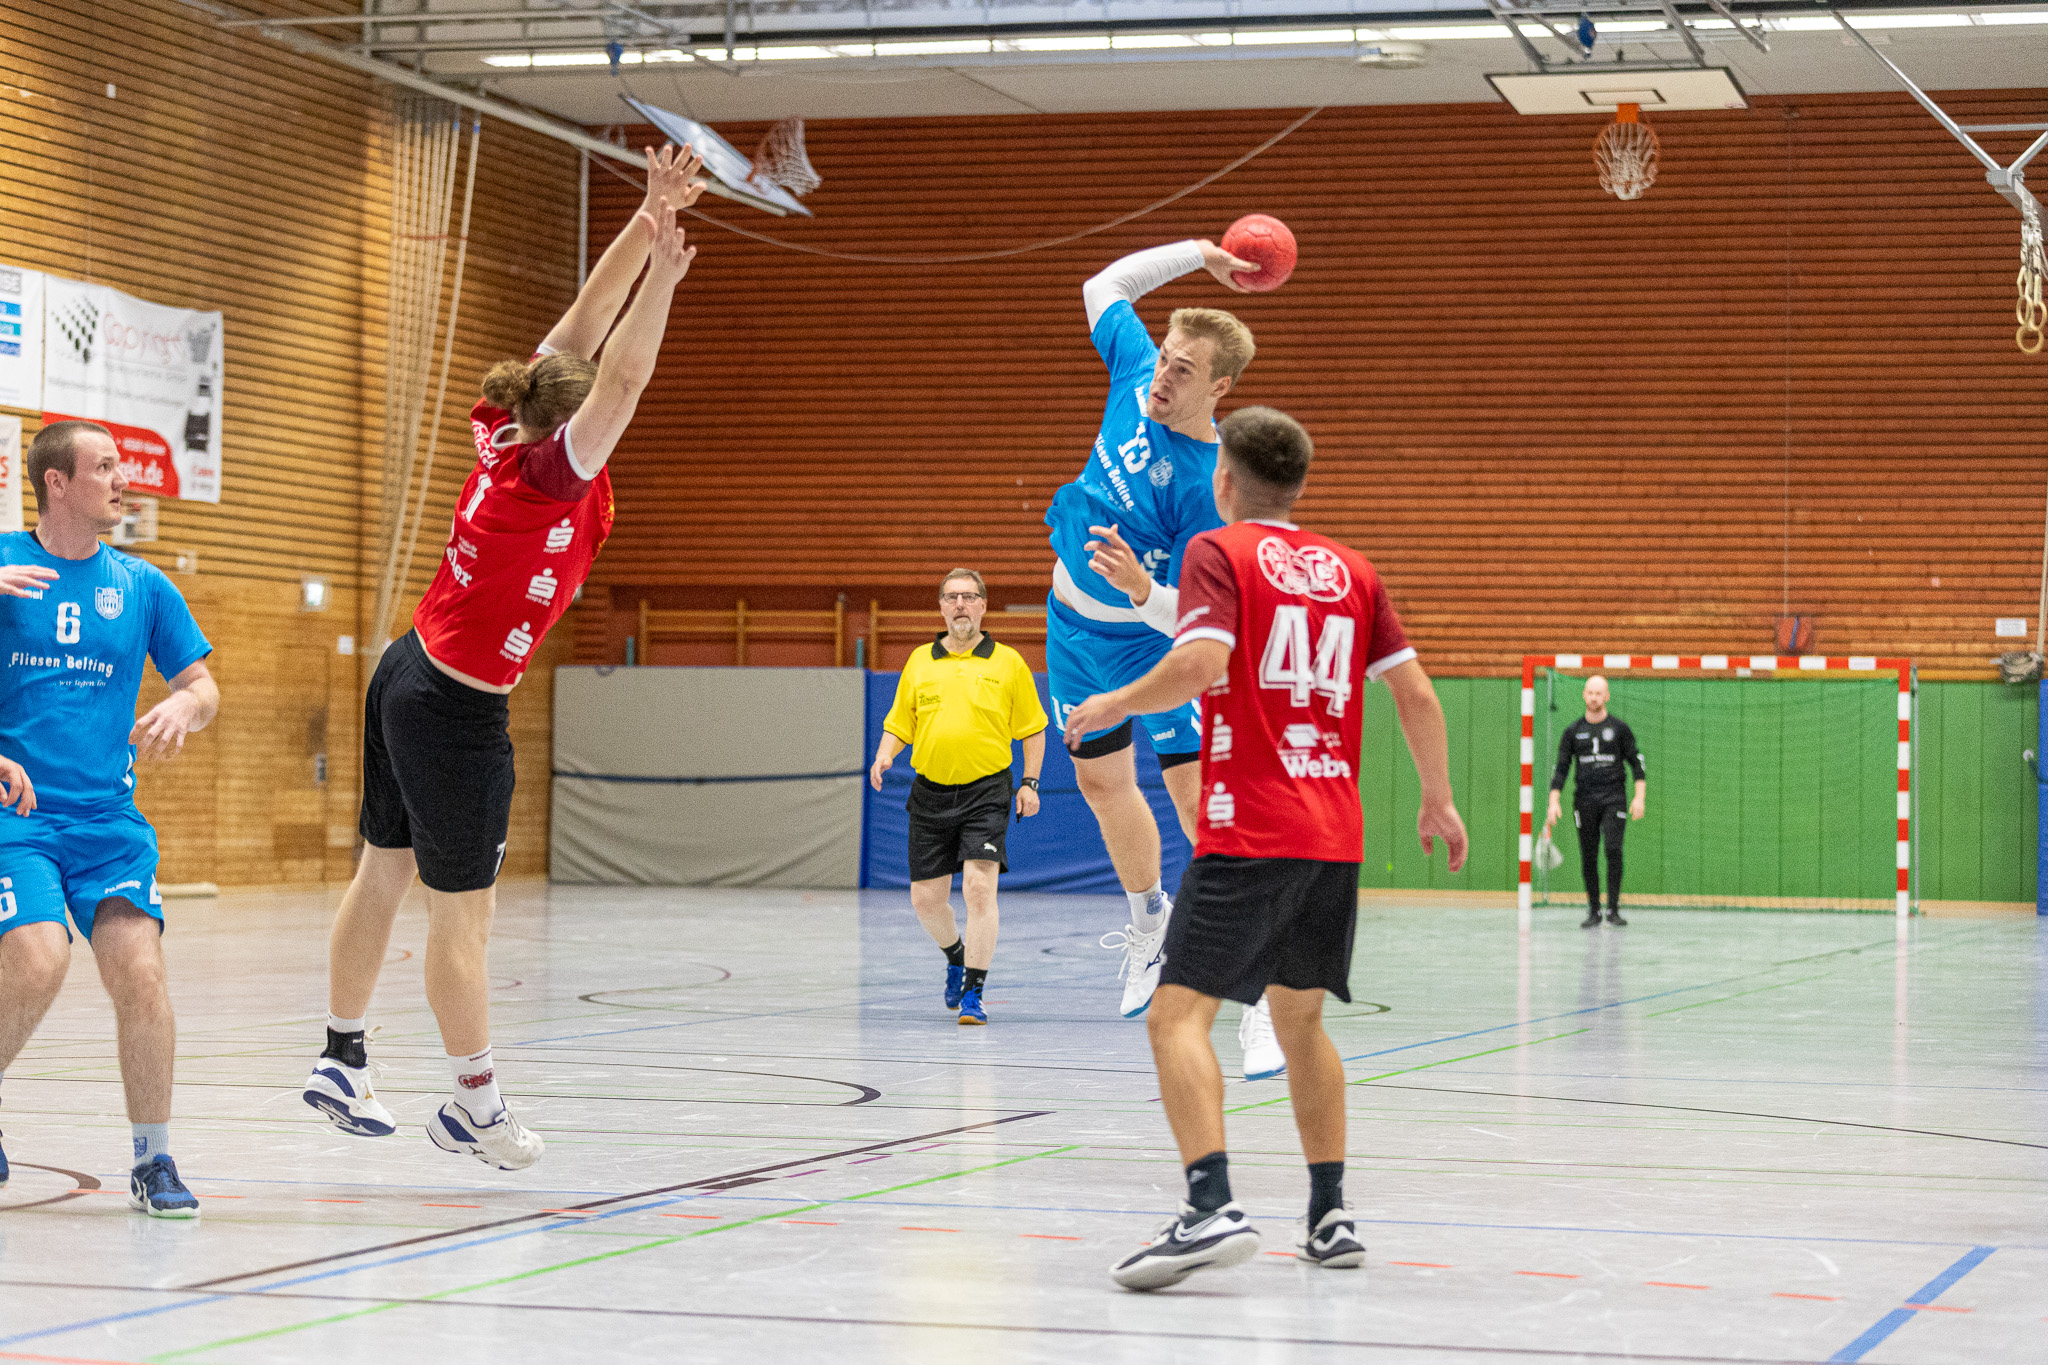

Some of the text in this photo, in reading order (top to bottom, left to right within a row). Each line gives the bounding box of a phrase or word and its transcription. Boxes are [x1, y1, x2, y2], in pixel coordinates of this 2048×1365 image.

[1117, 421, 1151, 474] 13
[56, 601, 81, 644] 6
[11, 652, 114, 678] Fliesen Belting
[1258, 604, 1355, 719] 44
